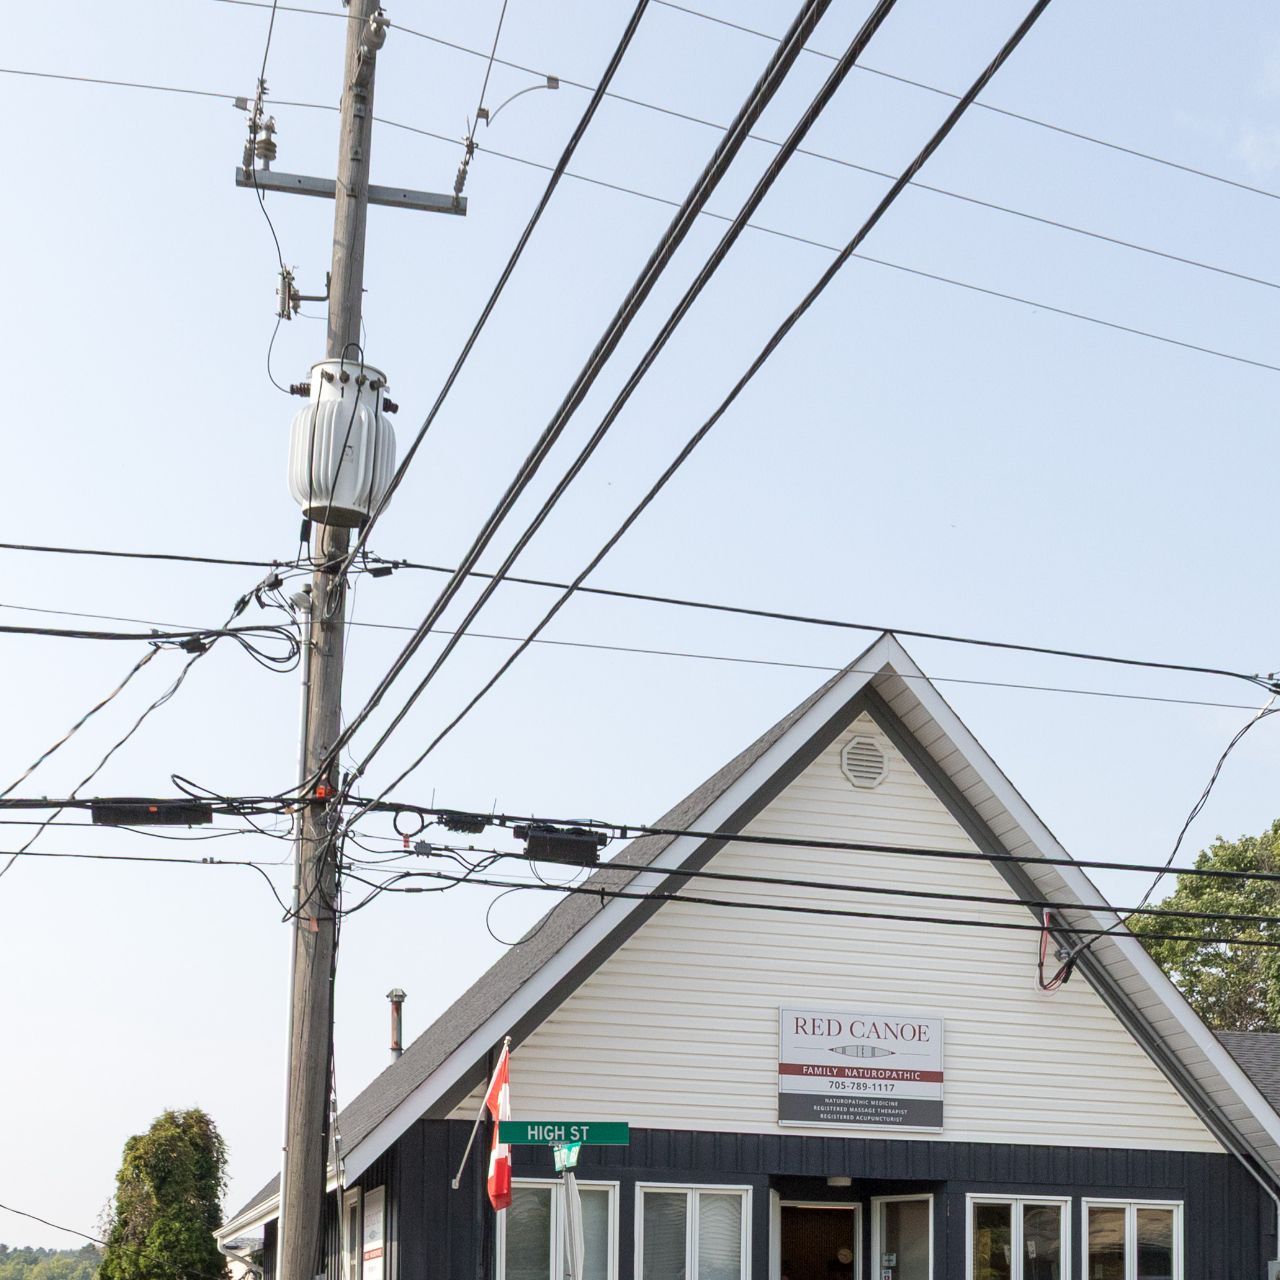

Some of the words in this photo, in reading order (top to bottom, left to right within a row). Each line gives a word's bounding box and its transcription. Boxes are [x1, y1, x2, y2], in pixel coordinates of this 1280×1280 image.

[793, 1016, 843, 1037] RED
[849, 1020, 930, 1042] CANOE
[802, 1066, 838, 1077] FAMILY
[845, 1068, 921, 1080] NATUROPATHIC
[828, 1080, 895, 1092] 705-789-1117
[870, 1099, 899, 1107] MEDICINE
[849, 1106, 876, 1114] MASSAGE
[855, 1114, 903, 1122] ACUPUNCTURIST
[527, 1125, 565, 1140] HIGH
[570, 1126, 590, 1140] ST
